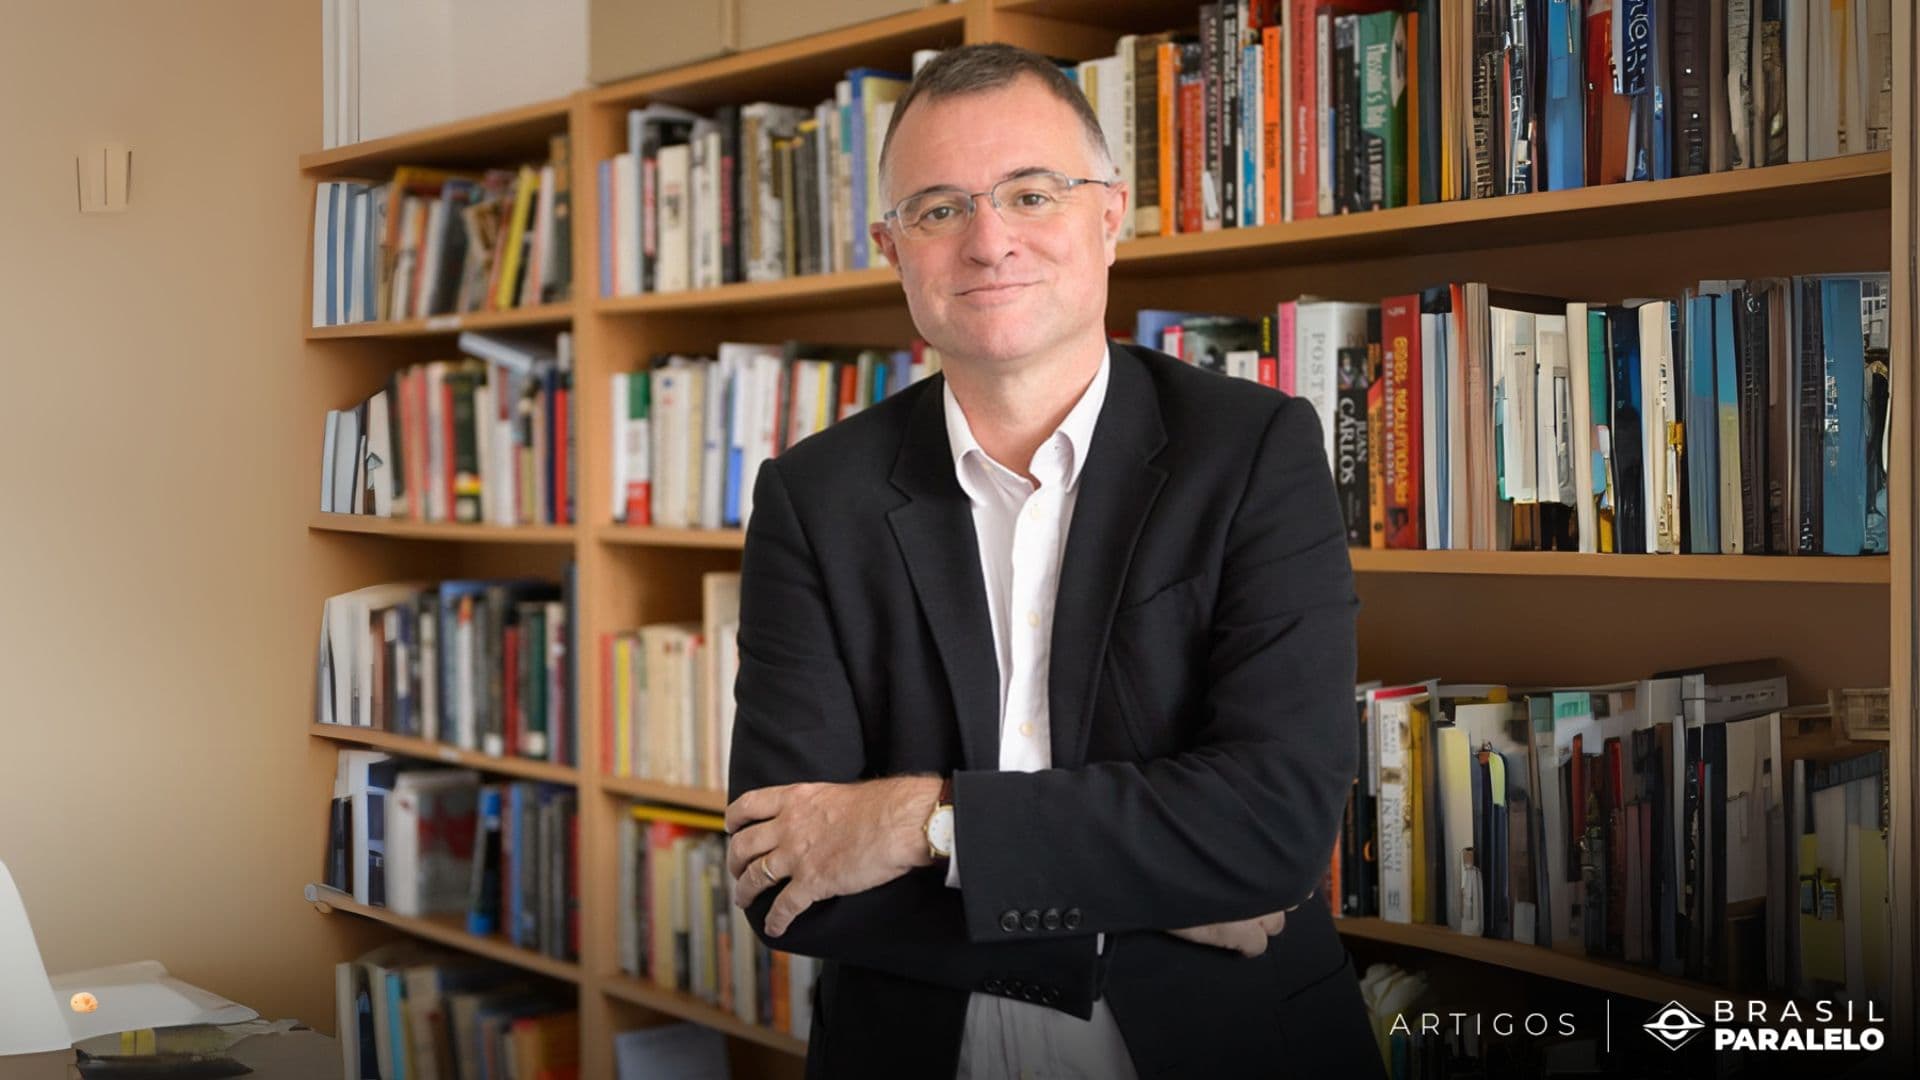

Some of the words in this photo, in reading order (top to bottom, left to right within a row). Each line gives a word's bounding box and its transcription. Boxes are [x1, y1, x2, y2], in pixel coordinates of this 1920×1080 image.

[1339, 397, 1356, 484] CARLOS
[1357, 420, 1368, 462] JUAN
[1393, 388, 1409, 505] REVOLUTION
